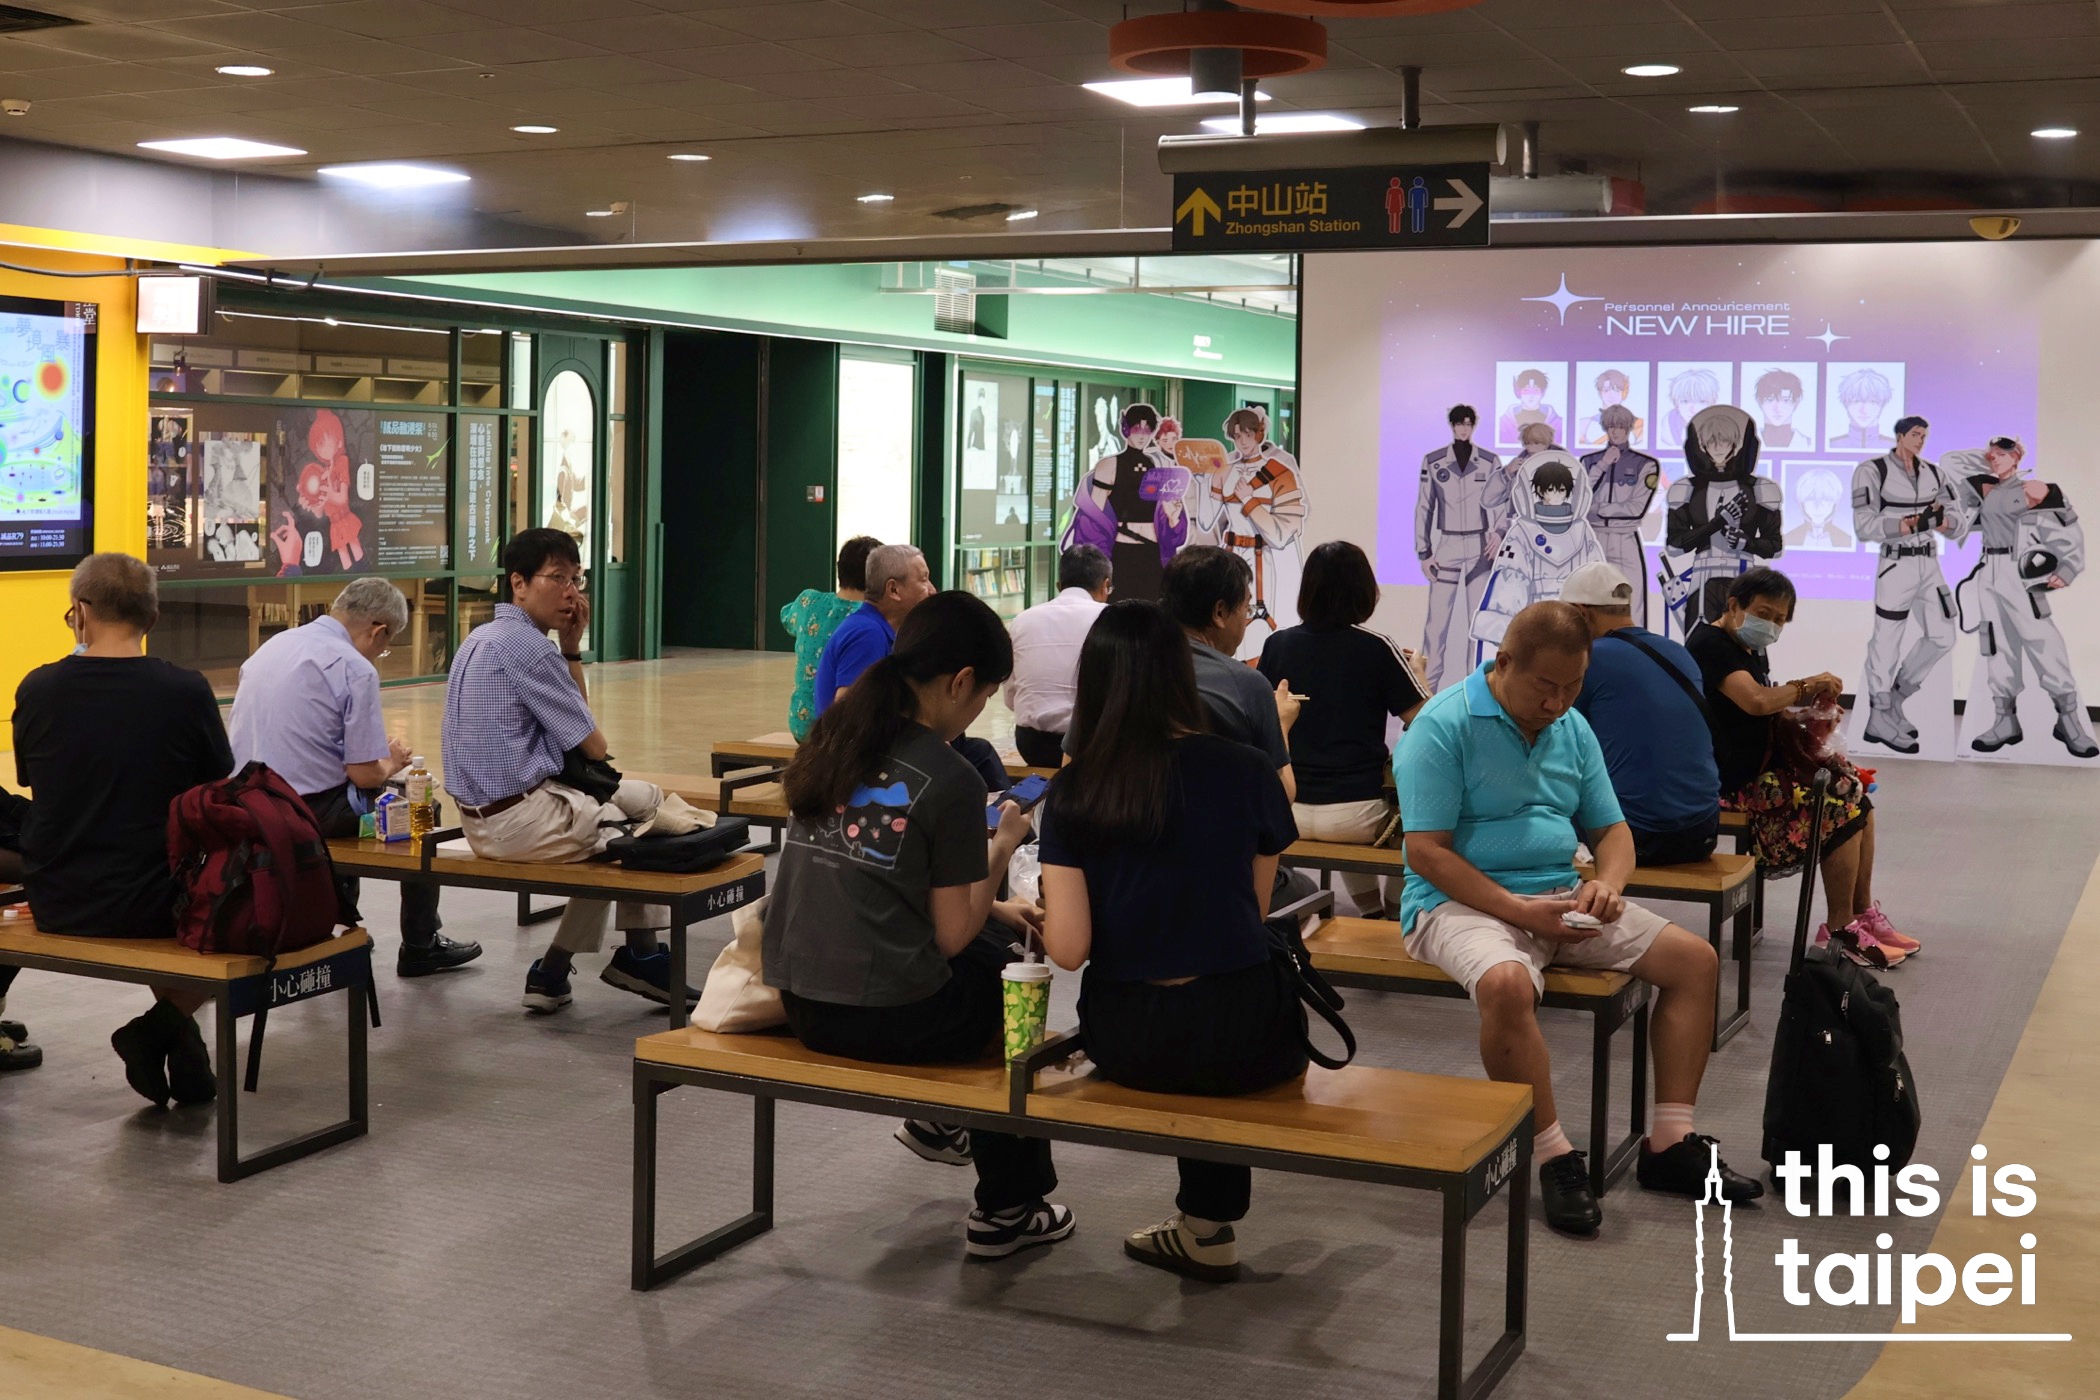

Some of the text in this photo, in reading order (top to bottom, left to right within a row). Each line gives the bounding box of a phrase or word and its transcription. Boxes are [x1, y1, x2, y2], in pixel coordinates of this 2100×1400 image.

[1227, 181, 1328, 218] 中山站
[1225, 219, 1361, 236] Zhongshan Station
[1604, 301, 1791, 312] Personnel Announcement
[1606, 314, 1790, 336] NEW HIRE
[484, 490, 492, 544] Cyberpunk
[270, 964, 333, 1003] 小心碰撞
